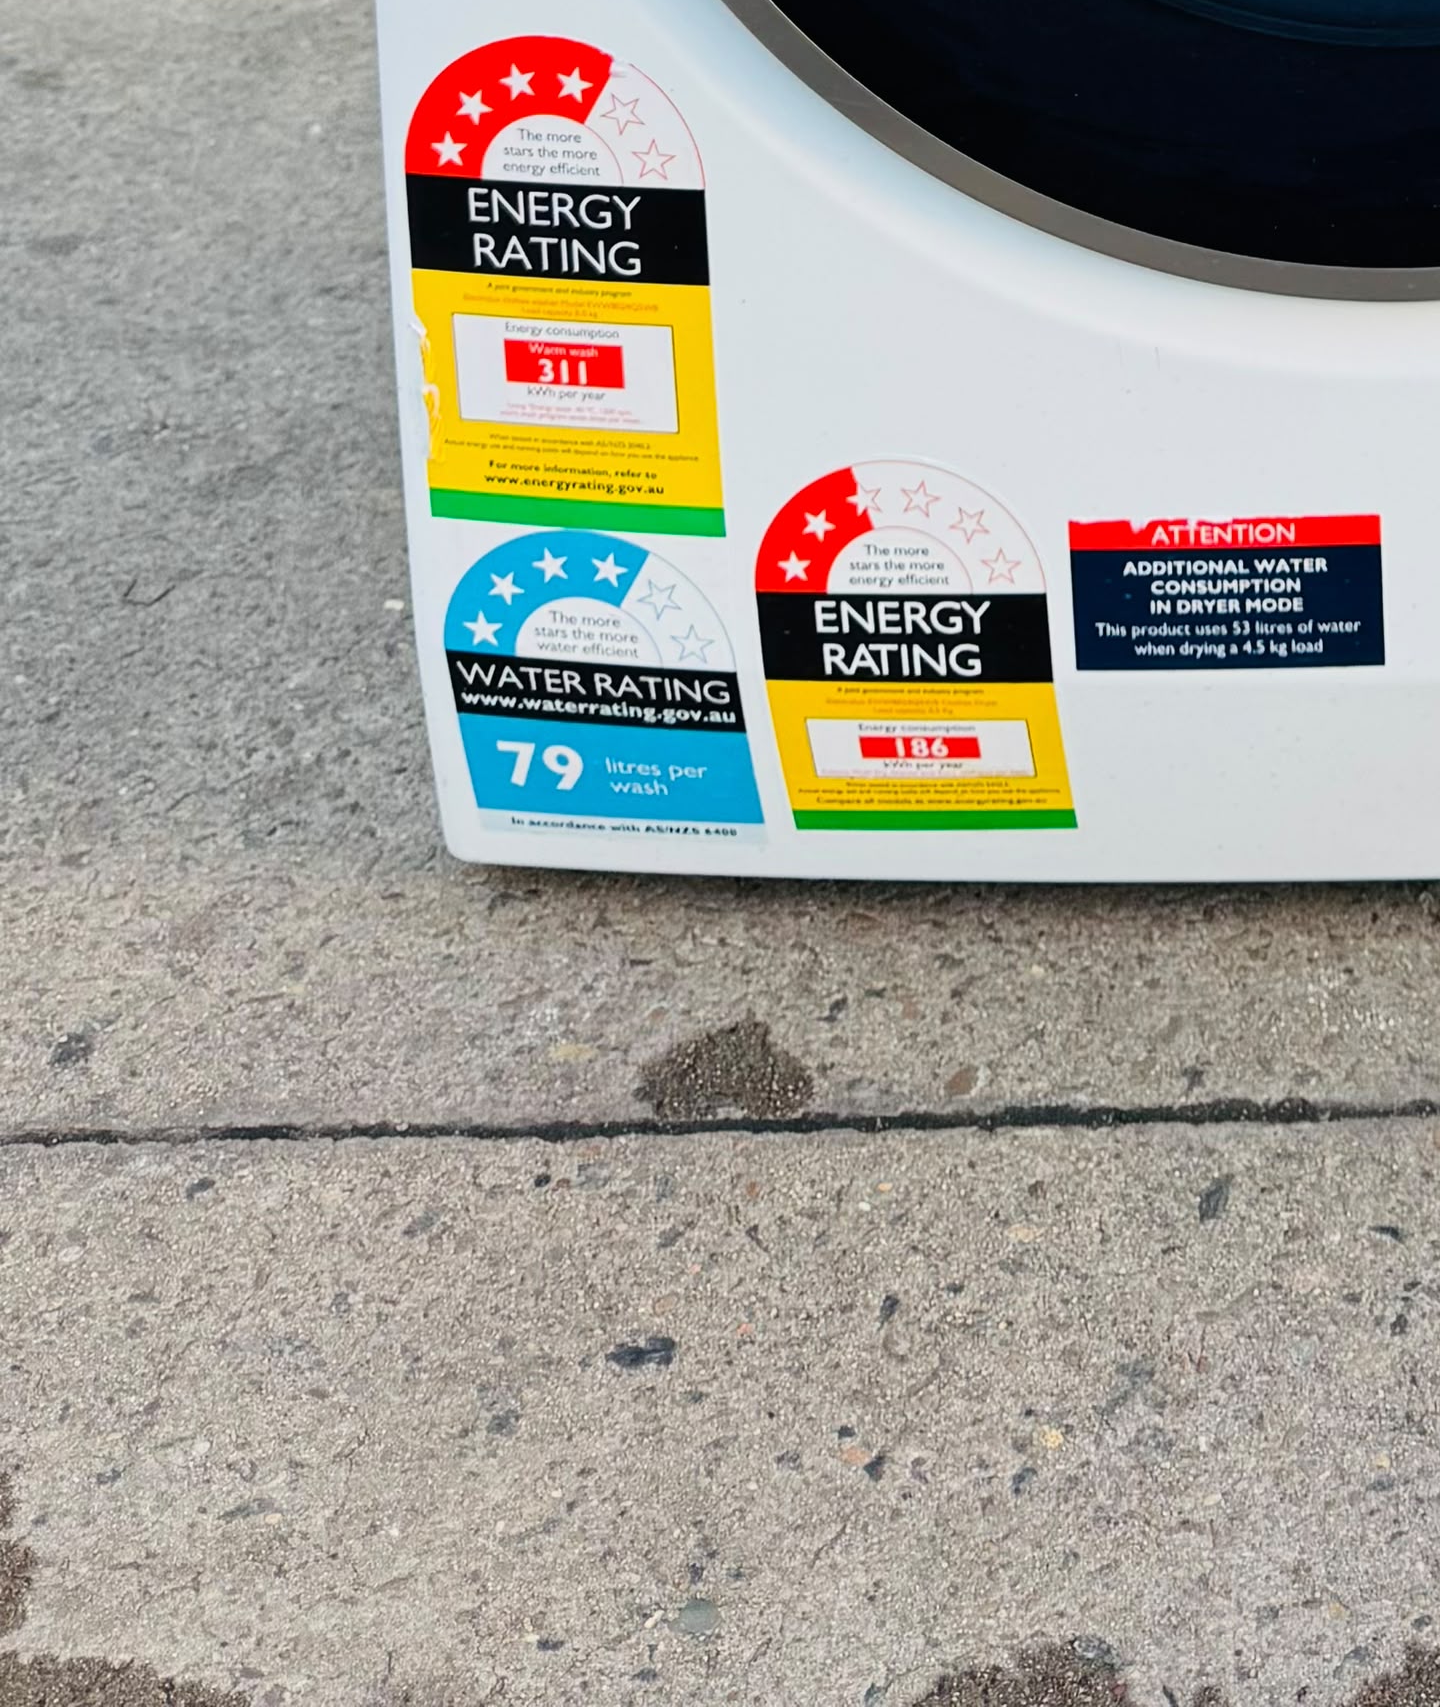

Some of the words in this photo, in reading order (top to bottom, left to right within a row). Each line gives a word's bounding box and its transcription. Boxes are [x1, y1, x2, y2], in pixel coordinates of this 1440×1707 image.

[518, 128, 543, 142] The
[547, 132, 582, 143] more
[504, 146, 534, 158] stars
[538, 147, 559, 158] the
[562, 150, 597, 161] more
[503, 164, 546, 176] energy
[550, 163, 601, 177] efficient
[468, 187, 641, 230] ENERGY
[473, 232, 642, 276] RATING
[505, 321, 543, 336] Energy
[546, 324, 620, 339] consumption
[529, 342, 566, 356] Warm
[570, 346, 598, 357] wash
[537, 359, 589, 385] 311
[528, 386, 555, 398] kWh
[559, 389, 578, 401] per
[582, 391, 606, 402] year
[489, 459, 508, 471] For
[510, 462, 540, 473] more
[543, 463, 612, 479] information,
[614, 469, 642, 480] refer
[645, 470, 657, 480] to
[484, 473, 665, 496] www.energyrating.gov.au
[1151, 523, 1296, 546] ATTENTION
[864, 544, 897, 557] The
[902, 545, 929, 557] more
[849, 560, 880, 572] stars
[884, 559, 906, 571] the
[909, 561, 945, 572] more
[1123, 559, 1249, 576] ADDITIONAL
[1254, 557, 1327, 573] WATER
[849, 575, 894, 588] energy
[898, 573, 950, 586] efficient
[1151, 578, 1301, 595] CONSUMPTION
[1150, 599, 1171, 615] IN
[1177, 598, 1240, 614] DRYER
[1245, 596, 1303, 613] MODE
[549, 609, 577, 626] The
[581, 614, 621, 629] more
[814, 600, 991, 636] ENERGY
[534, 625, 568, 641] stars
[572, 627, 595, 642] the
[599, 630, 639, 644] more
[1096, 622, 1126, 637] This
[1131, 622, 1190, 639] product
[1195, 625, 1228, 636] uses
[1232, 621, 1251, 636] 53
[1255, 620, 1293, 635] litres
[1297, 619, 1314, 633] of
[1317, 620, 1361, 634] water
[537, 641, 579, 655] water
[582, 641, 639, 659] efficient
[1135, 642, 1175, 656] when
[1179, 641, 1226, 659] drying
[1230, 645, 1238, 655] a
[1242, 640, 1265, 654] 4.5
[1269, 640, 1288, 658] kg
[1291, 639, 1323, 654] load
[823, 642, 982, 677] RATING
[456, 660, 589, 694] WATER
[594, 672, 731, 705] RATING
[461, 690, 736, 725] www.waterrating.gov.au
[895, 737, 949, 758] 186
[496, 739, 584, 791] 79
[605, 756, 662, 777] litres
[669, 763, 707, 782] per
[609, 778, 669, 796] wash
